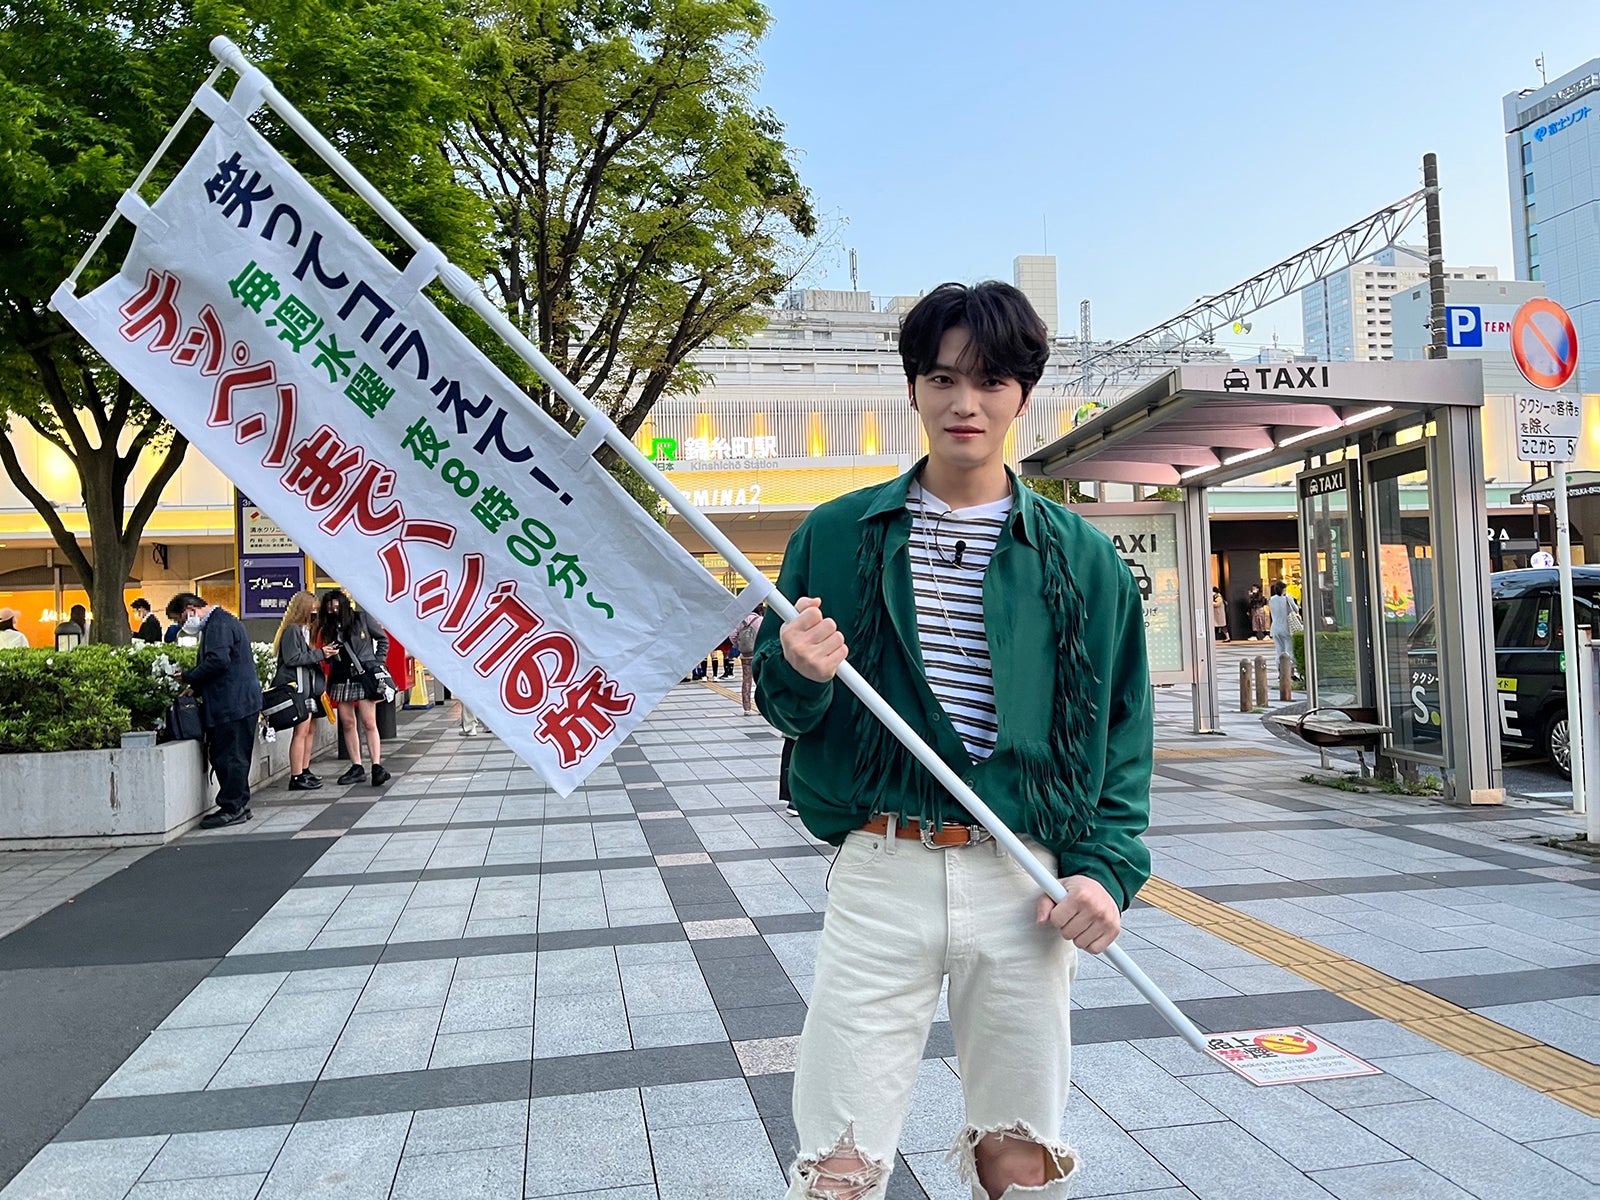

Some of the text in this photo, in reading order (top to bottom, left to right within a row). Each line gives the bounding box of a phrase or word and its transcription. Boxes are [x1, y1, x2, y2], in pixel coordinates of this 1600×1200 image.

[204, 151, 574, 506] 笑ってコラえて！
[1451, 309, 1476, 345] P
[228, 260, 396, 419] 毎週水曜
[1255, 366, 1329, 390] TAXI
[1519, 398, 1580, 417] タクシーの客待ち
[1521, 418, 1551, 435] を除く
[645, 437, 678, 461] JR
[684, 435, 778, 461] 錦糸町駅
[1522, 439, 1557, 454] ここから
[744, 459, 779, 470] Station
[1319, 473, 1343, 492] TAXI
[119, 267, 636, 769] テッペンまでハシゴの旅
[1113, 534, 1157, 553] AXI
